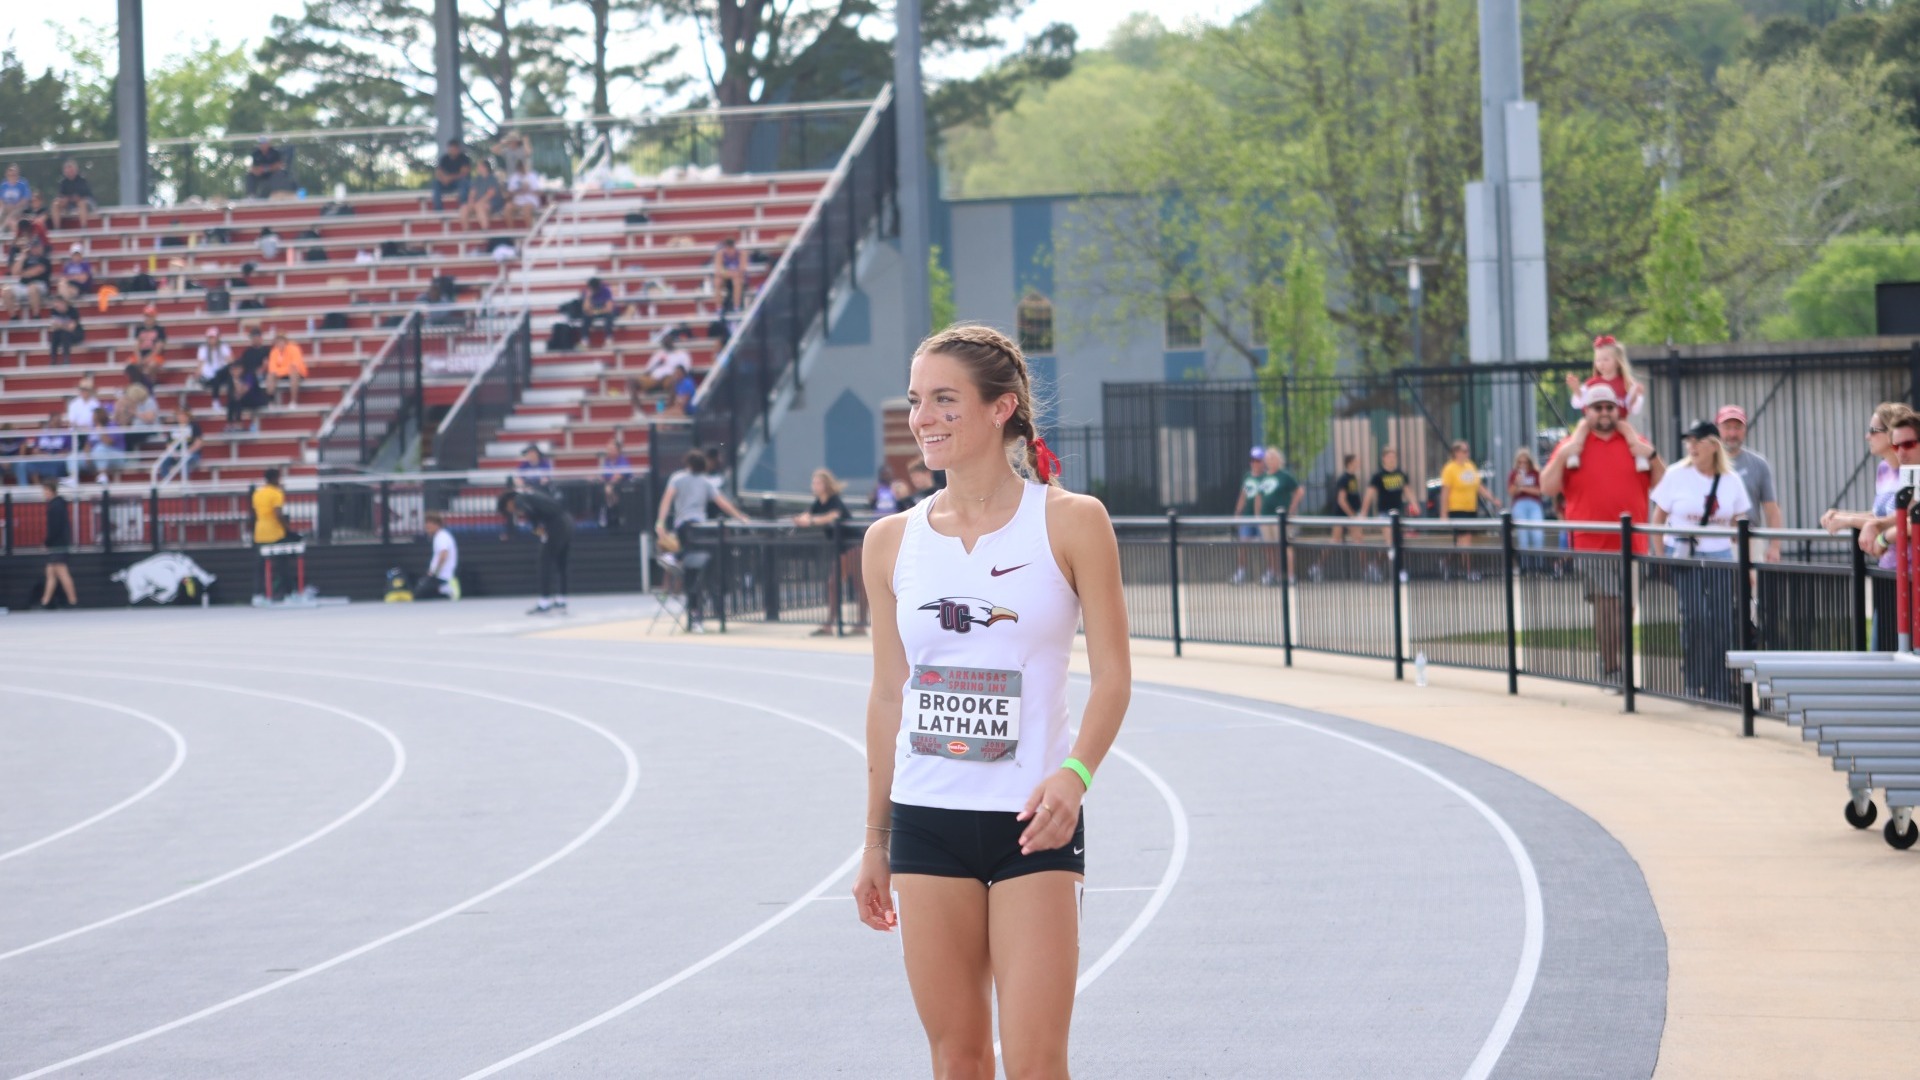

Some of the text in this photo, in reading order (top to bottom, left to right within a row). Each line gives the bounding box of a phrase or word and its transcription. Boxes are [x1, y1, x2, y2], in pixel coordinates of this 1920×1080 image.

[940, 601, 971, 634] OC
[948, 681, 1007, 693] SPRING INV
[949, 670, 1007, 682] ARKANSAS
[919, 693, 1009, 716] BROOKE
[918, 714, 1008, 737] LATHAM
